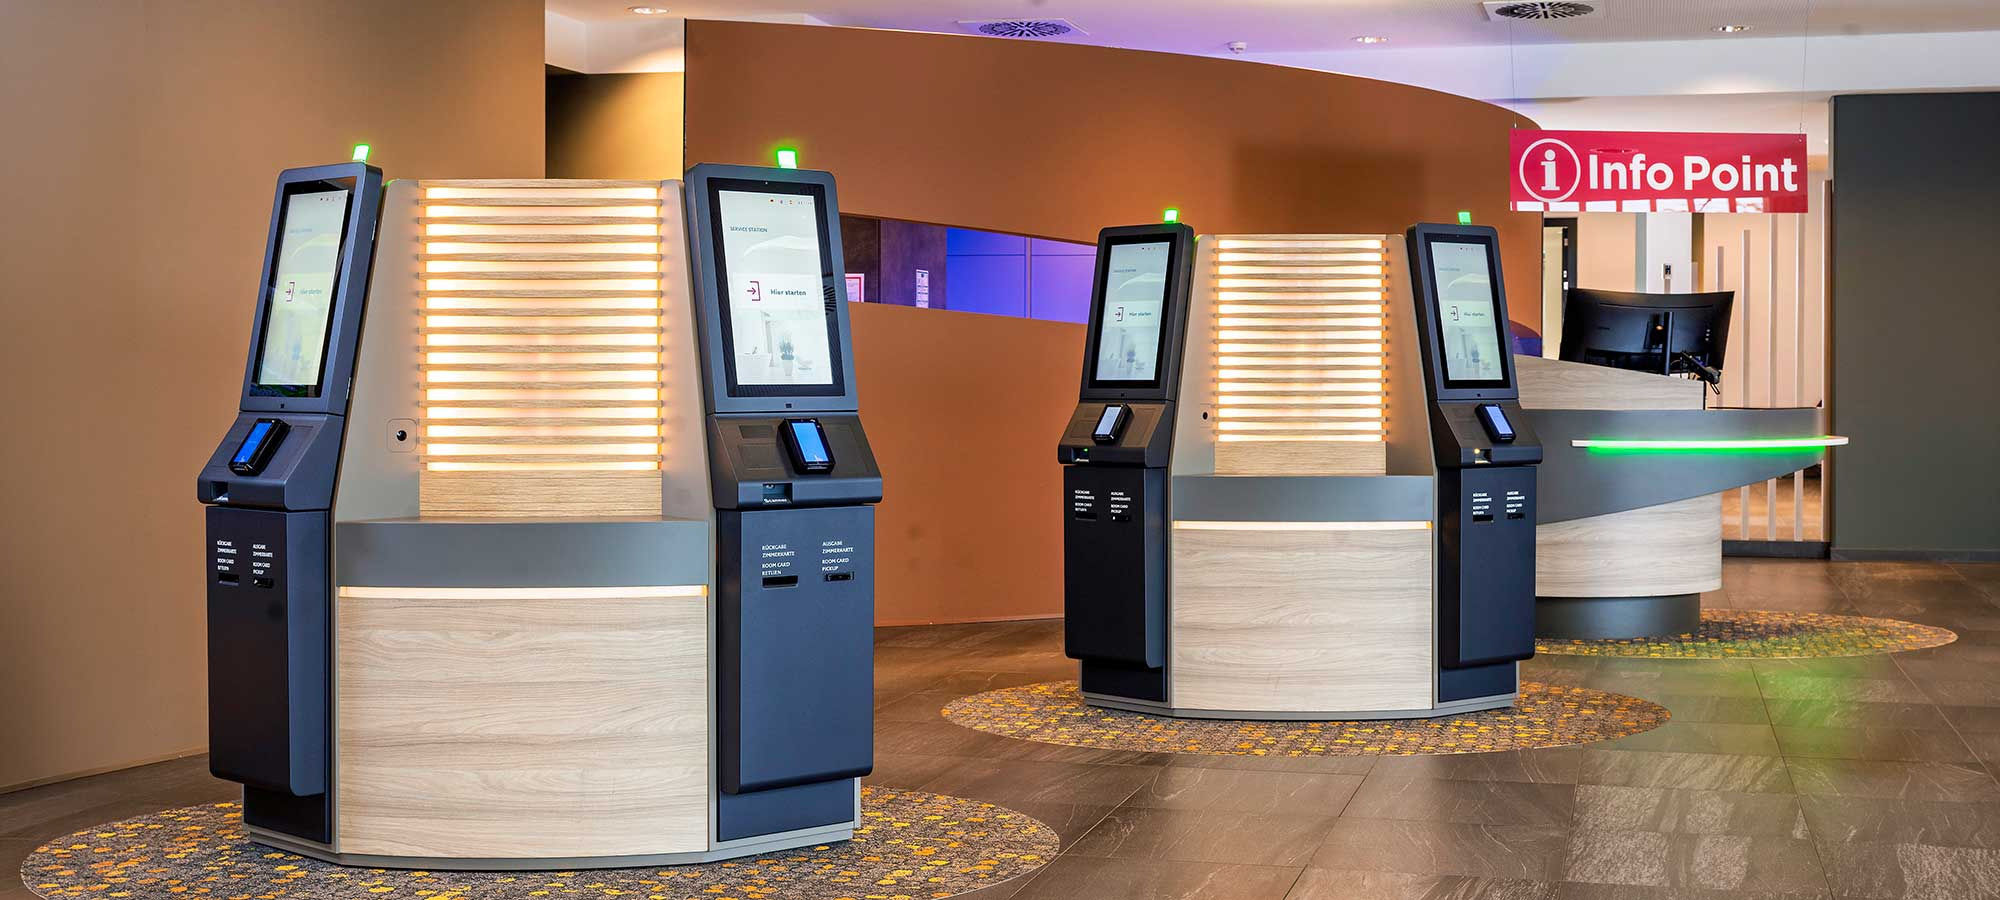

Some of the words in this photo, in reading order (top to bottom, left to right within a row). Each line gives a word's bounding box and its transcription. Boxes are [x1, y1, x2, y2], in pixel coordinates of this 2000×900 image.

[1588, 153, 1674, 191] Info
[1683, 155, 1798, 192] Point
[770, 288, 784, 296] Hier
